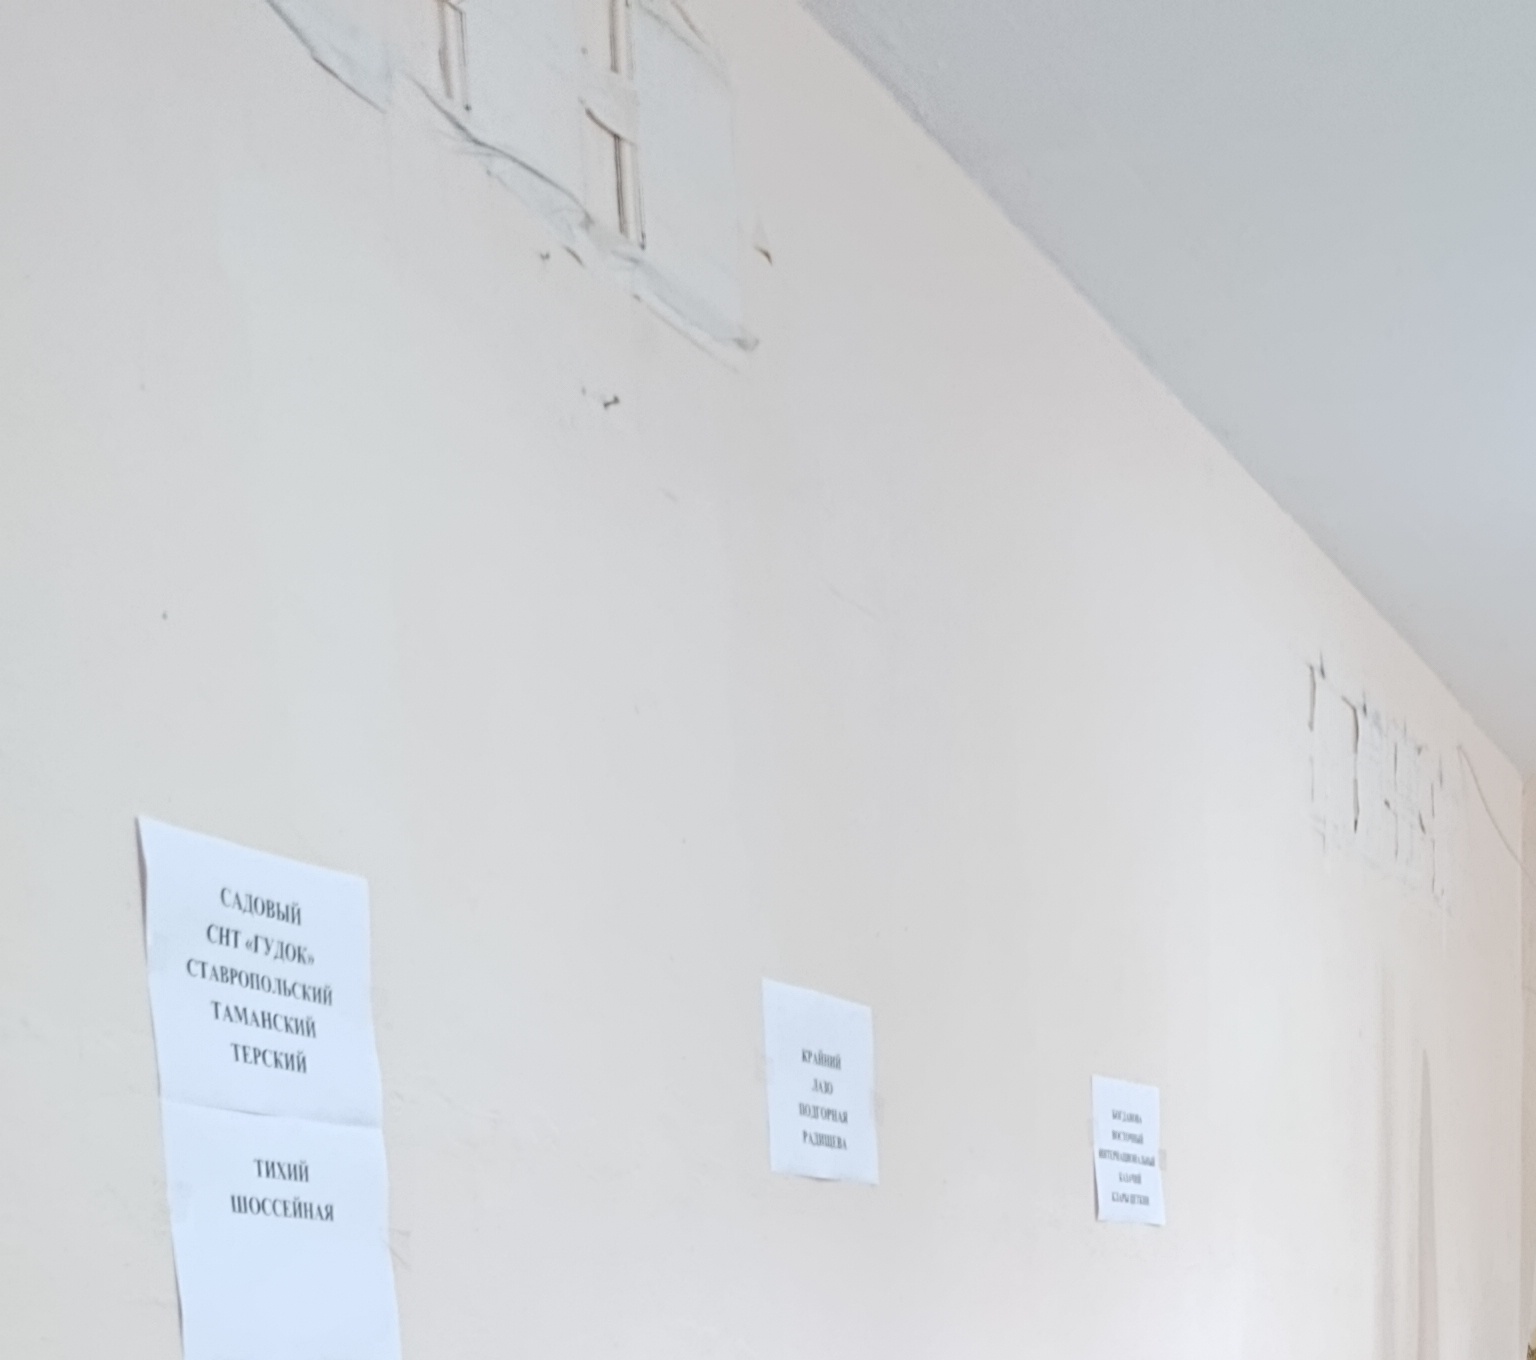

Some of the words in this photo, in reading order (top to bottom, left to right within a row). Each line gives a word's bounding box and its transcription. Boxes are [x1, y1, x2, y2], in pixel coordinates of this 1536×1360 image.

[220, 886, 302, 926] САДОВЫЙ
[206, 923, 241, 949] СНТ
[245, 934, 315, 965] «ГУДОК»
[186, 957, 333, 1007] СТАВРОПОЛЬСКИЙ
[210, 1000, 317, 1039] ТАМАНСКИЙ
[230, 1042, 308, 1075] ТЕРСКИЙ
[802, 1049, 841, 1069] КРАЙНИЙ
[811, 1078, 833, 1095] ЛАЗО
[799, 1103, 847, 1123] ПОДГОРНАЯ
[803, 1130, 846, 1149] РАДИЩЕВА
[252, 1158, 309, 1183] ТИХИЙ
[230, 1194, 334, 1222] ШОССЕЙНАЯ
